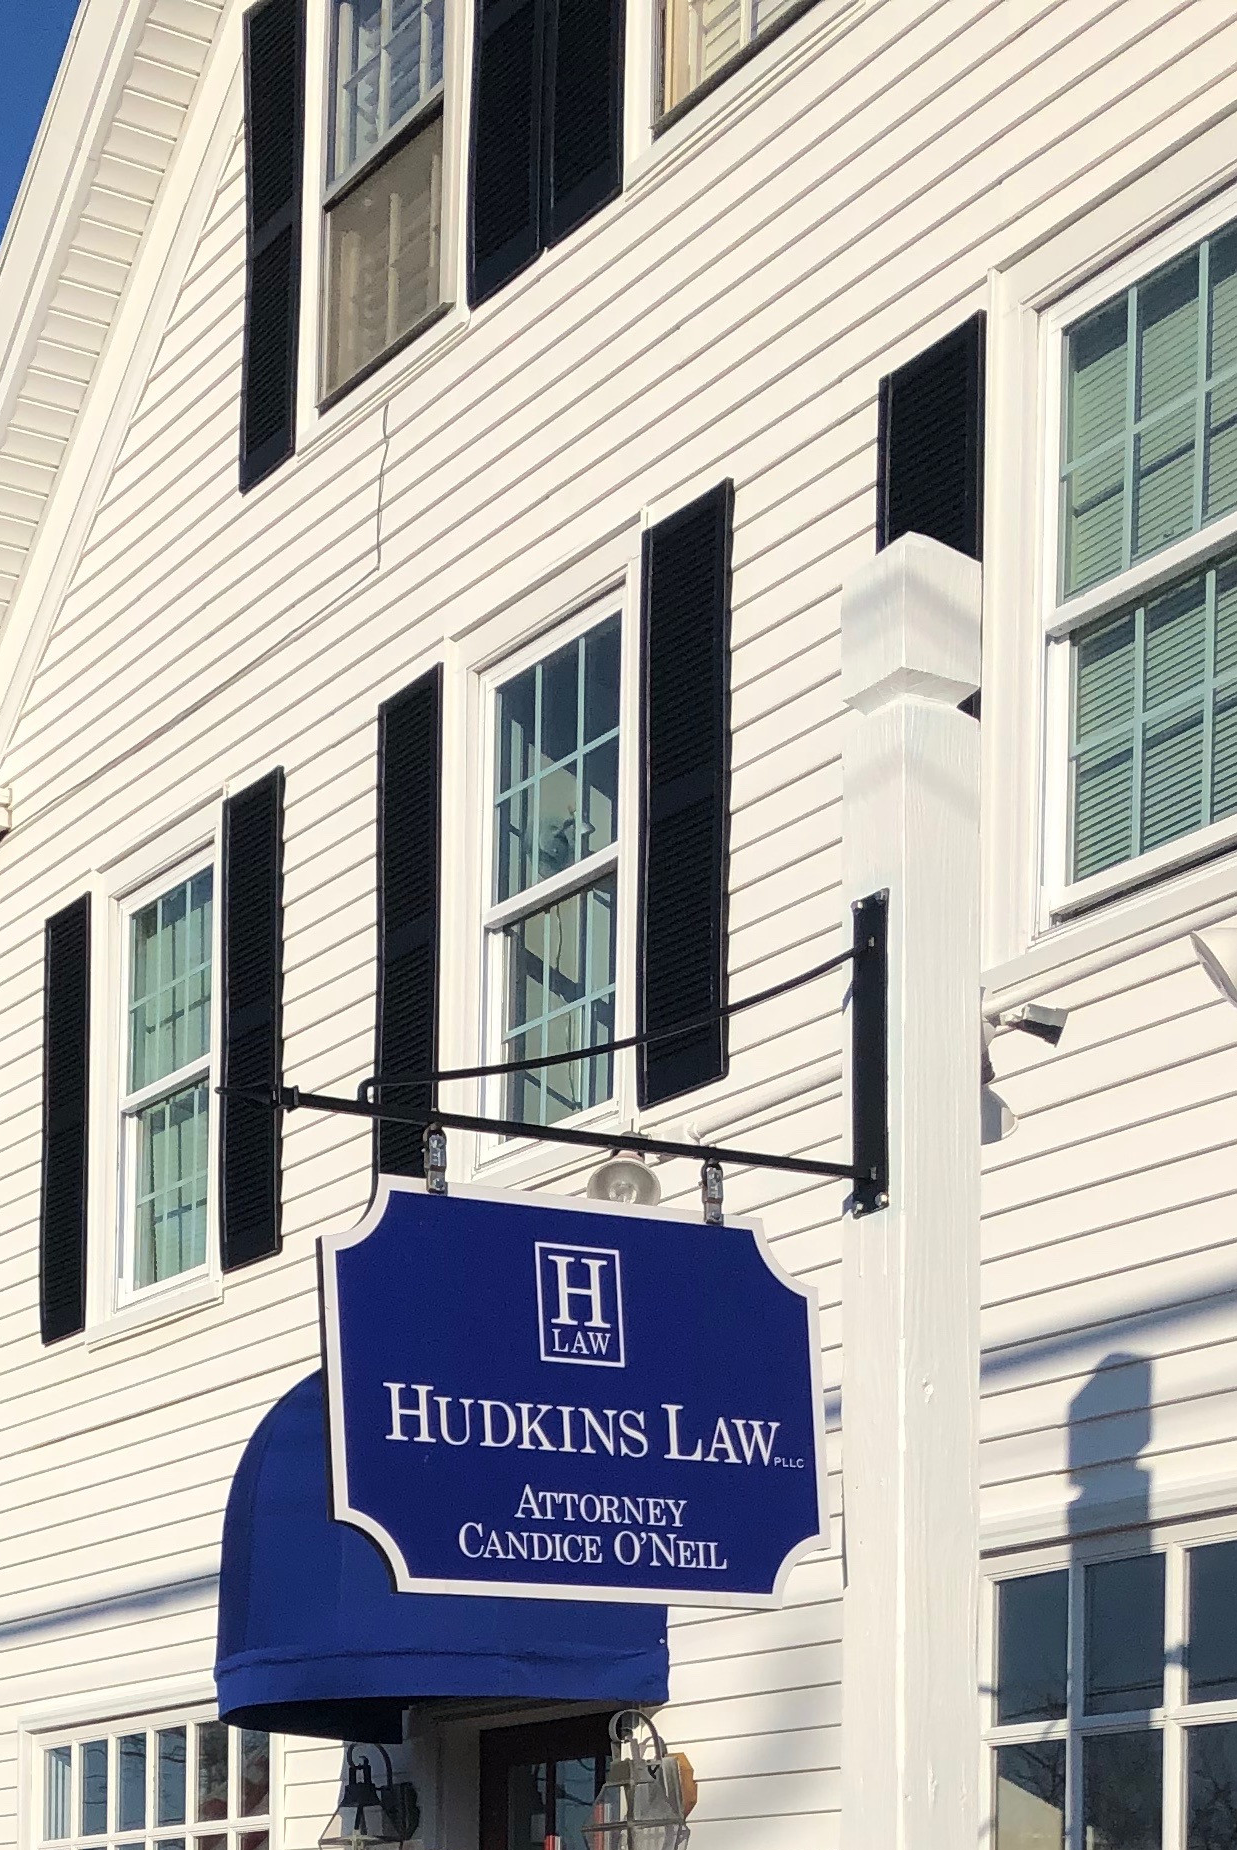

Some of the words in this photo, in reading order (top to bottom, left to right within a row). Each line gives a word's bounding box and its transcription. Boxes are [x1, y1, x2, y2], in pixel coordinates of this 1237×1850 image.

[547, 1254, 612, 1329] H
[551, 1328, 612, 1355] LAW
[382, 1381, 649, 1458] HUDKINS
[660, 1403, 781, 1467] LAW
[773, 1456, 805, 1469] PLLC
[514, 1483, 688, 1528] ATTORNEY
[458, 1522, 603, 1564] CANDICE
[613, 1530, 728, 1570] O'NEIL
